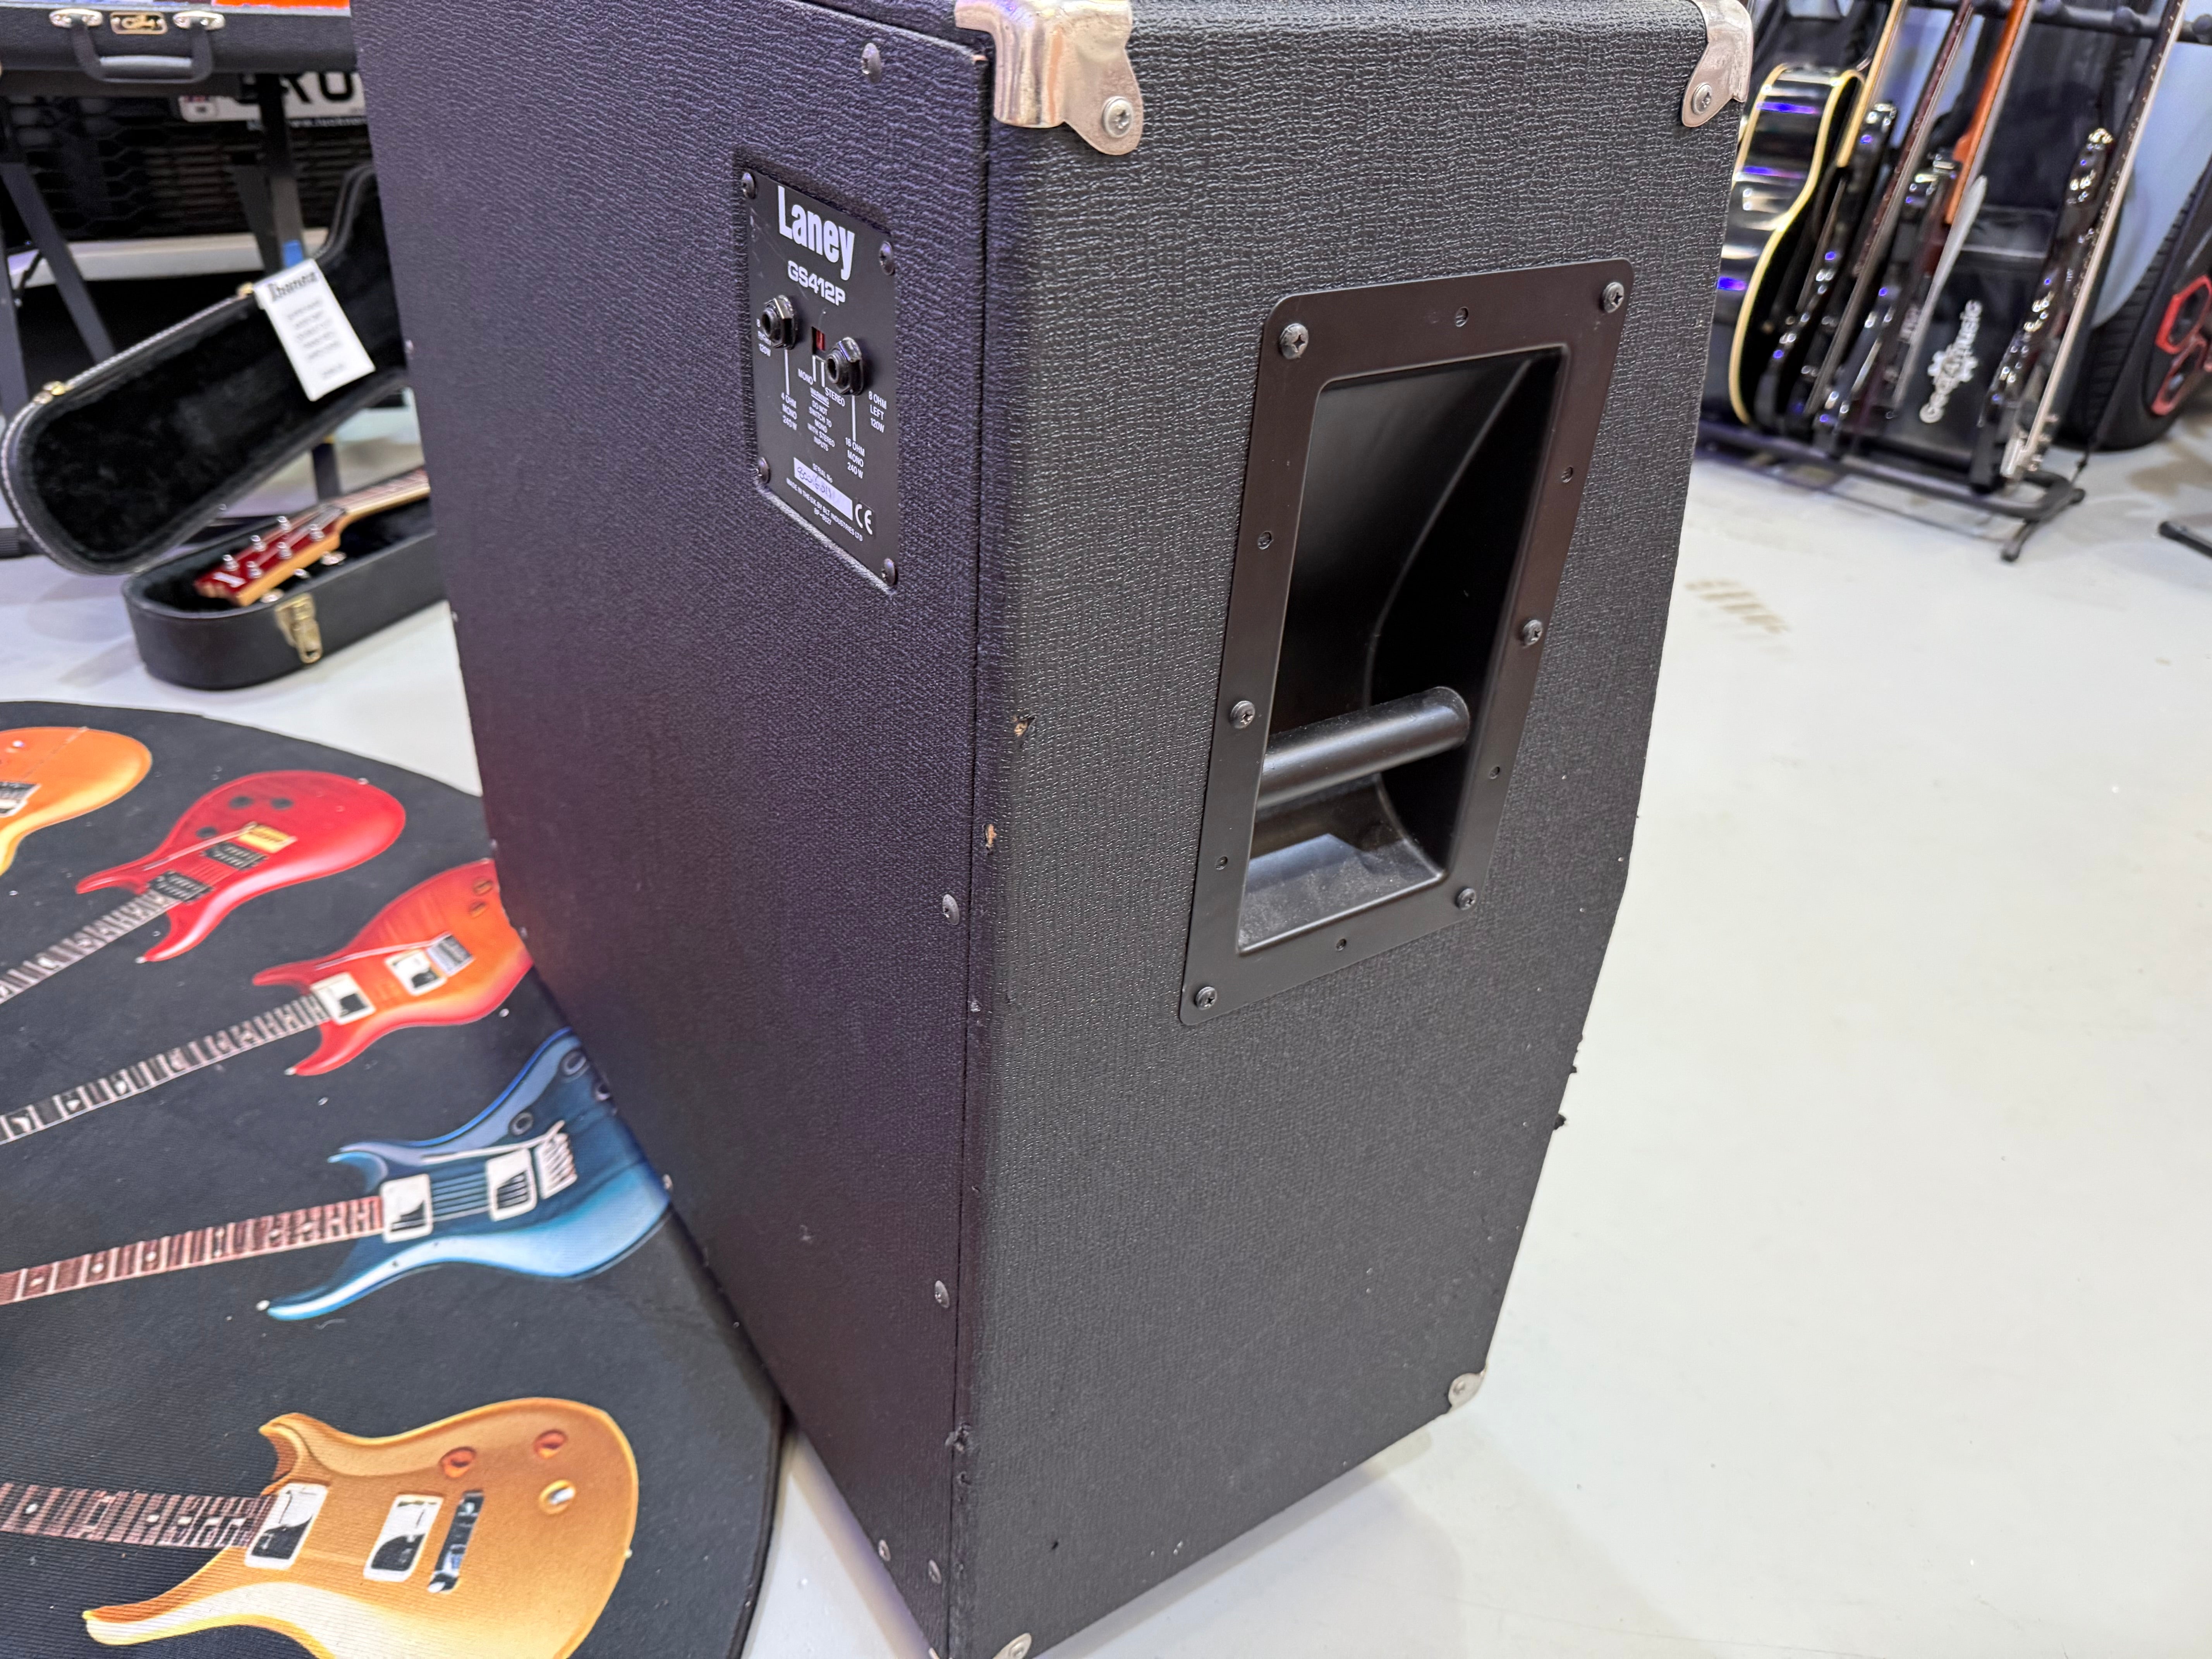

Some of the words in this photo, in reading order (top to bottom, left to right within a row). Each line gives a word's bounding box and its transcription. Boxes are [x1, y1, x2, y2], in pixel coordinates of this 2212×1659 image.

[778, 185, 855, 281] Laney
[788, 260, 845, 306] GS412P
[798, 368, 814, 385] MONO
[825, 387, 845, 407] STEREO
[869, 391, 873, 400] 8
[873, 394, 887, 409] OHM
[781, 403, 797, 420] MONO
[870, 404, 884, 420] LEFT
[870, 417, 885, 433] 120W
[845, 437, 852, 447] 16
[852, 441, 865, 457] OHM
[847, 450, 864, 467] MONO
[855, 531, 863, 541] LTD
